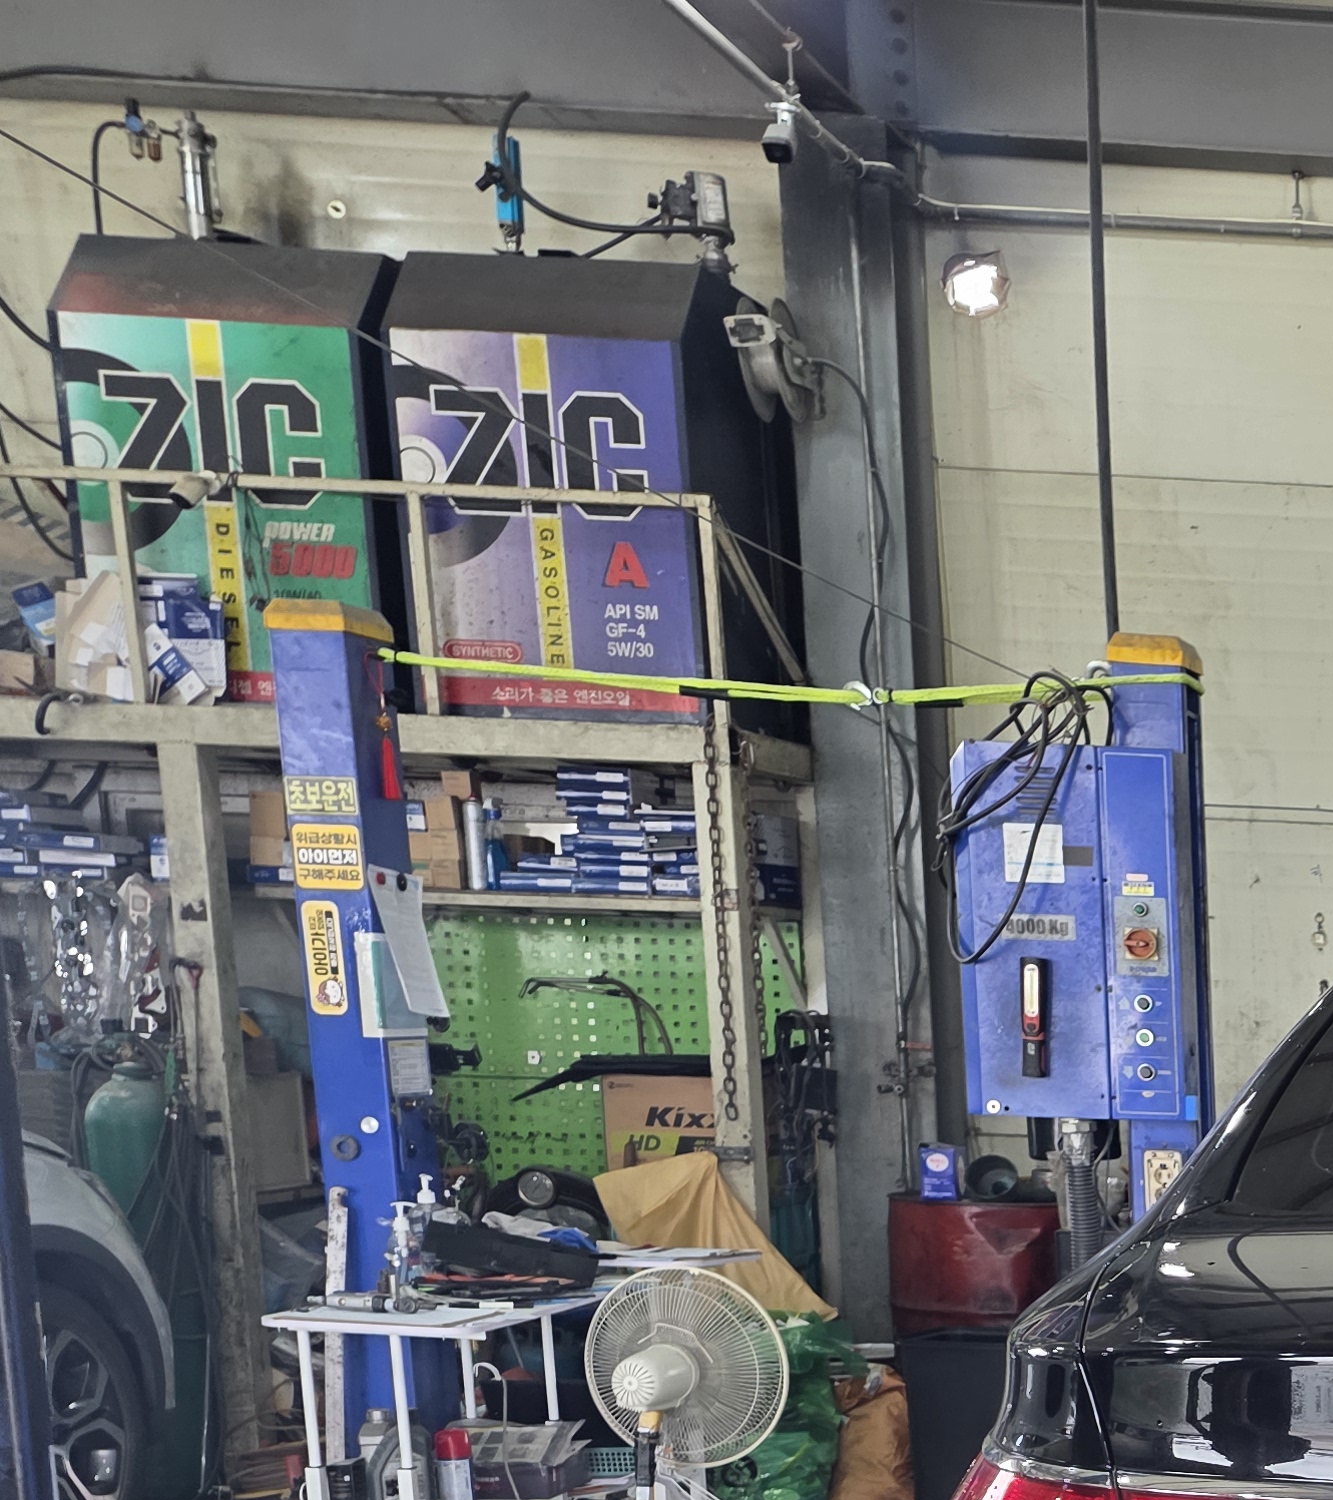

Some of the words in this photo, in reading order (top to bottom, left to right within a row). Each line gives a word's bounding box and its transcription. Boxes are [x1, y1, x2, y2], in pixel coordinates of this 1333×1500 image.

[98, 368, 326, 510] ZIC
[429, 384, 649, 521] ZIC
[262, 521, 335, 548] POWER
[603, 541, 649, 588] A
[215, 522, 241, 653] DIESEL
[539, 527, 565, 665] GASOLINE
[604, 603, 631, 619] API
[634, 604, 659, 620] SM
[605, 622, 646, 638] GF-4
[451, 643, 514, 659] SYNTHETIC
[607, 641, 654, 658] 5W/30
[491, 686, 535, 703] 소리가
[288, 779, 356, 813] 초보운전
[295, 831, 358, 846] 위급상황시
[298, 847, 358, 865] 아이먼저
[299, 867, 361, 882] 구해주세요
[1049, 918, 1069, 937] Kg
[310, 931, 329, 976] 아이가
